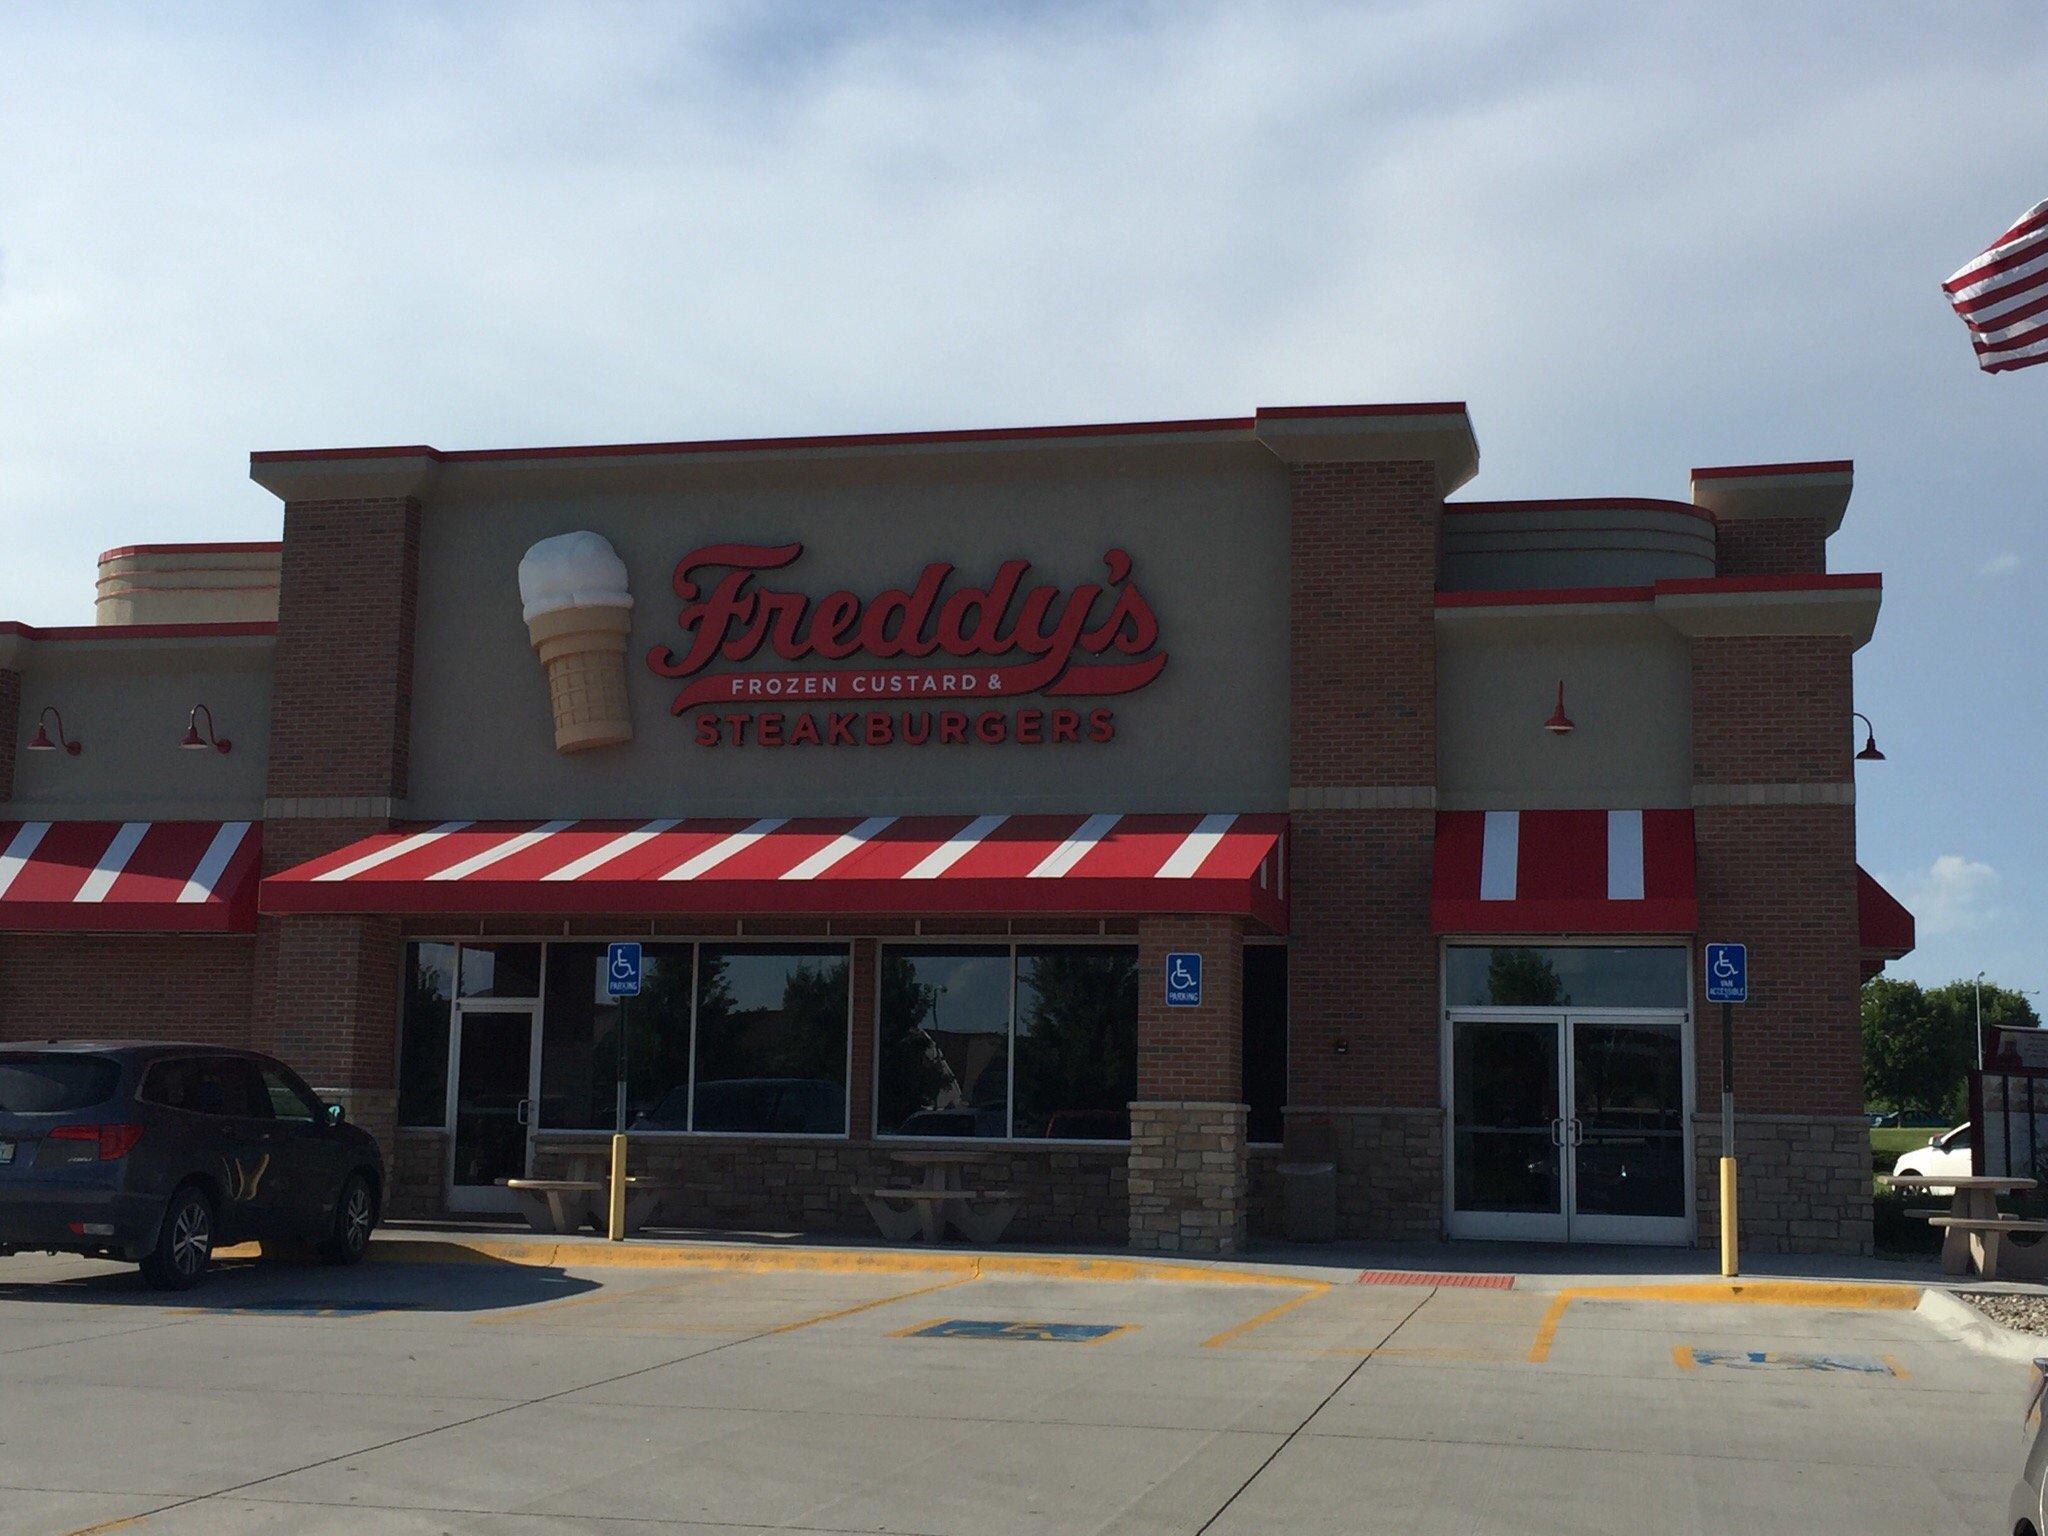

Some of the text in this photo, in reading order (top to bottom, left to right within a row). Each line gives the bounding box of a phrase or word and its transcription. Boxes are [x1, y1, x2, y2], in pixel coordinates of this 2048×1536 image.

[646, 541, 1166, 698] Freddy's
[731, 673, 1002, 695] FROZEN CUSTARD &
[693, 708, 1116, 747] STEAKBURGERS
[610, 981, 638, 991] PARKING
[1168, 992, 1199, 1002] PARKING
